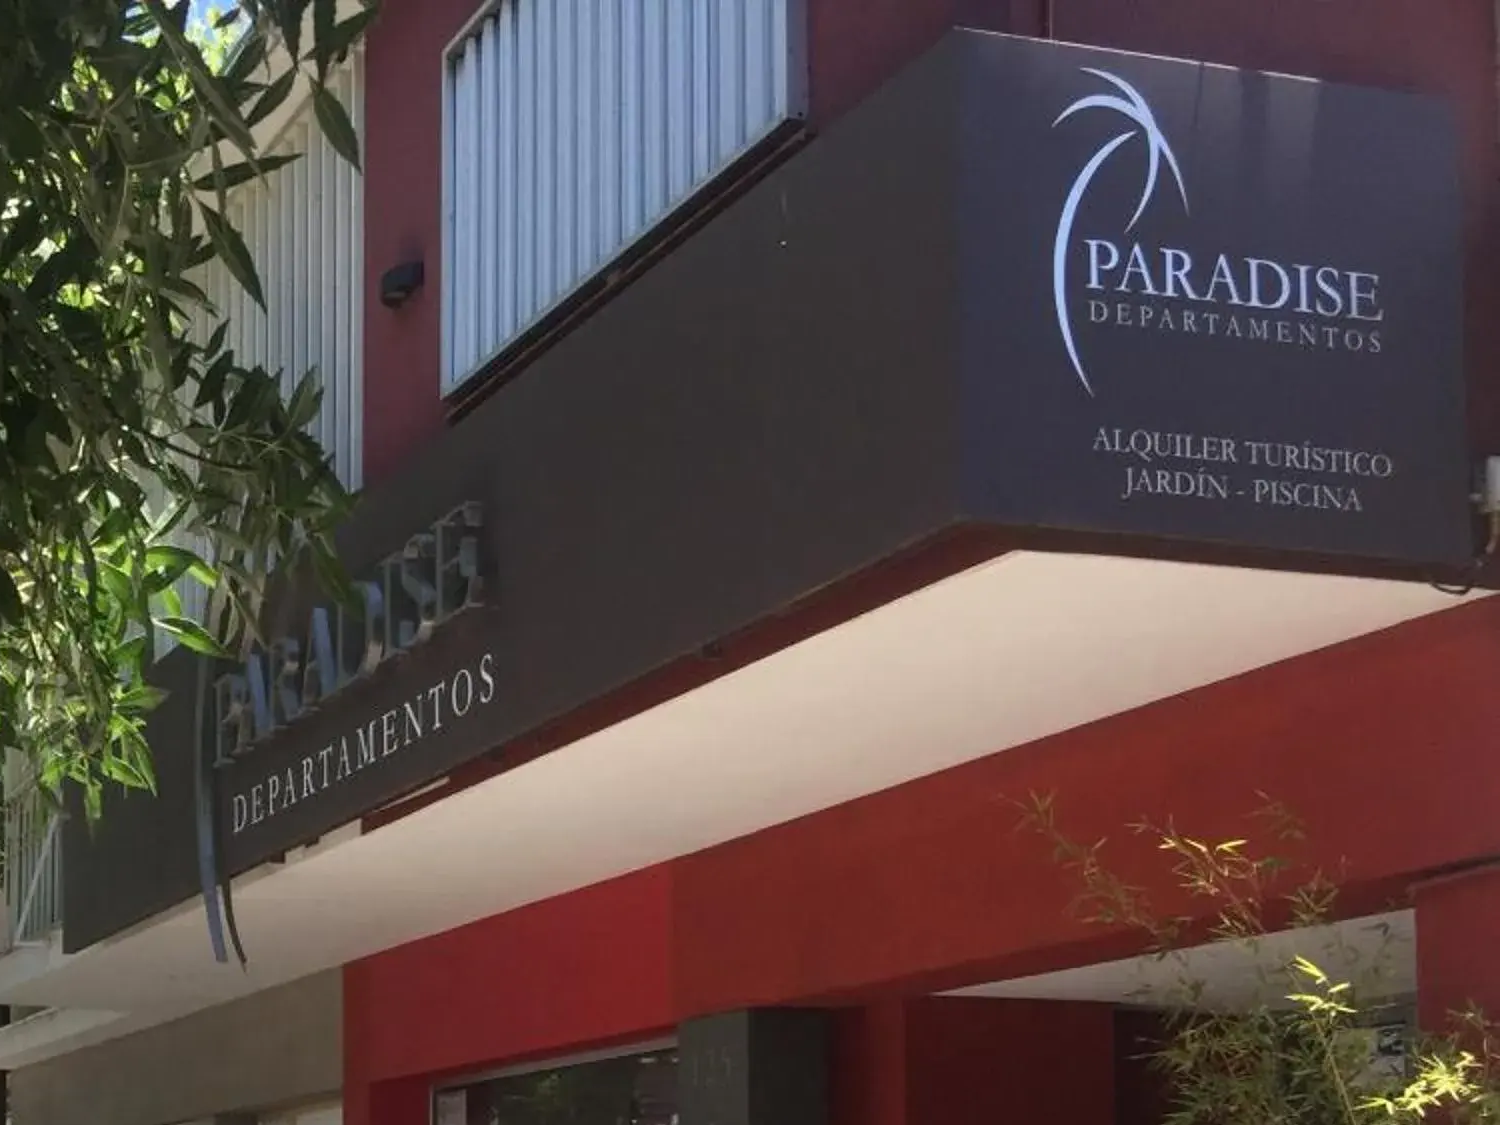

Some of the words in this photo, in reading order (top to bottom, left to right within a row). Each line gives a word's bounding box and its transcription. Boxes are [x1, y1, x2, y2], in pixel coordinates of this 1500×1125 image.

[1085, 239, 1384, 322] PARADISE
[1088, 299, 1383, 353] DEPARTAMENTOS
[1092, 426, 1237, 464] ALQUILER
[1245, 440, 1393, 478] TURÍSTICO
[1122, 467, 1228, 500] JARDÍN
[1254, 478, 1363, 512] PISCINA
[231, 652, 496, 834] DEPARTAMENTOS
